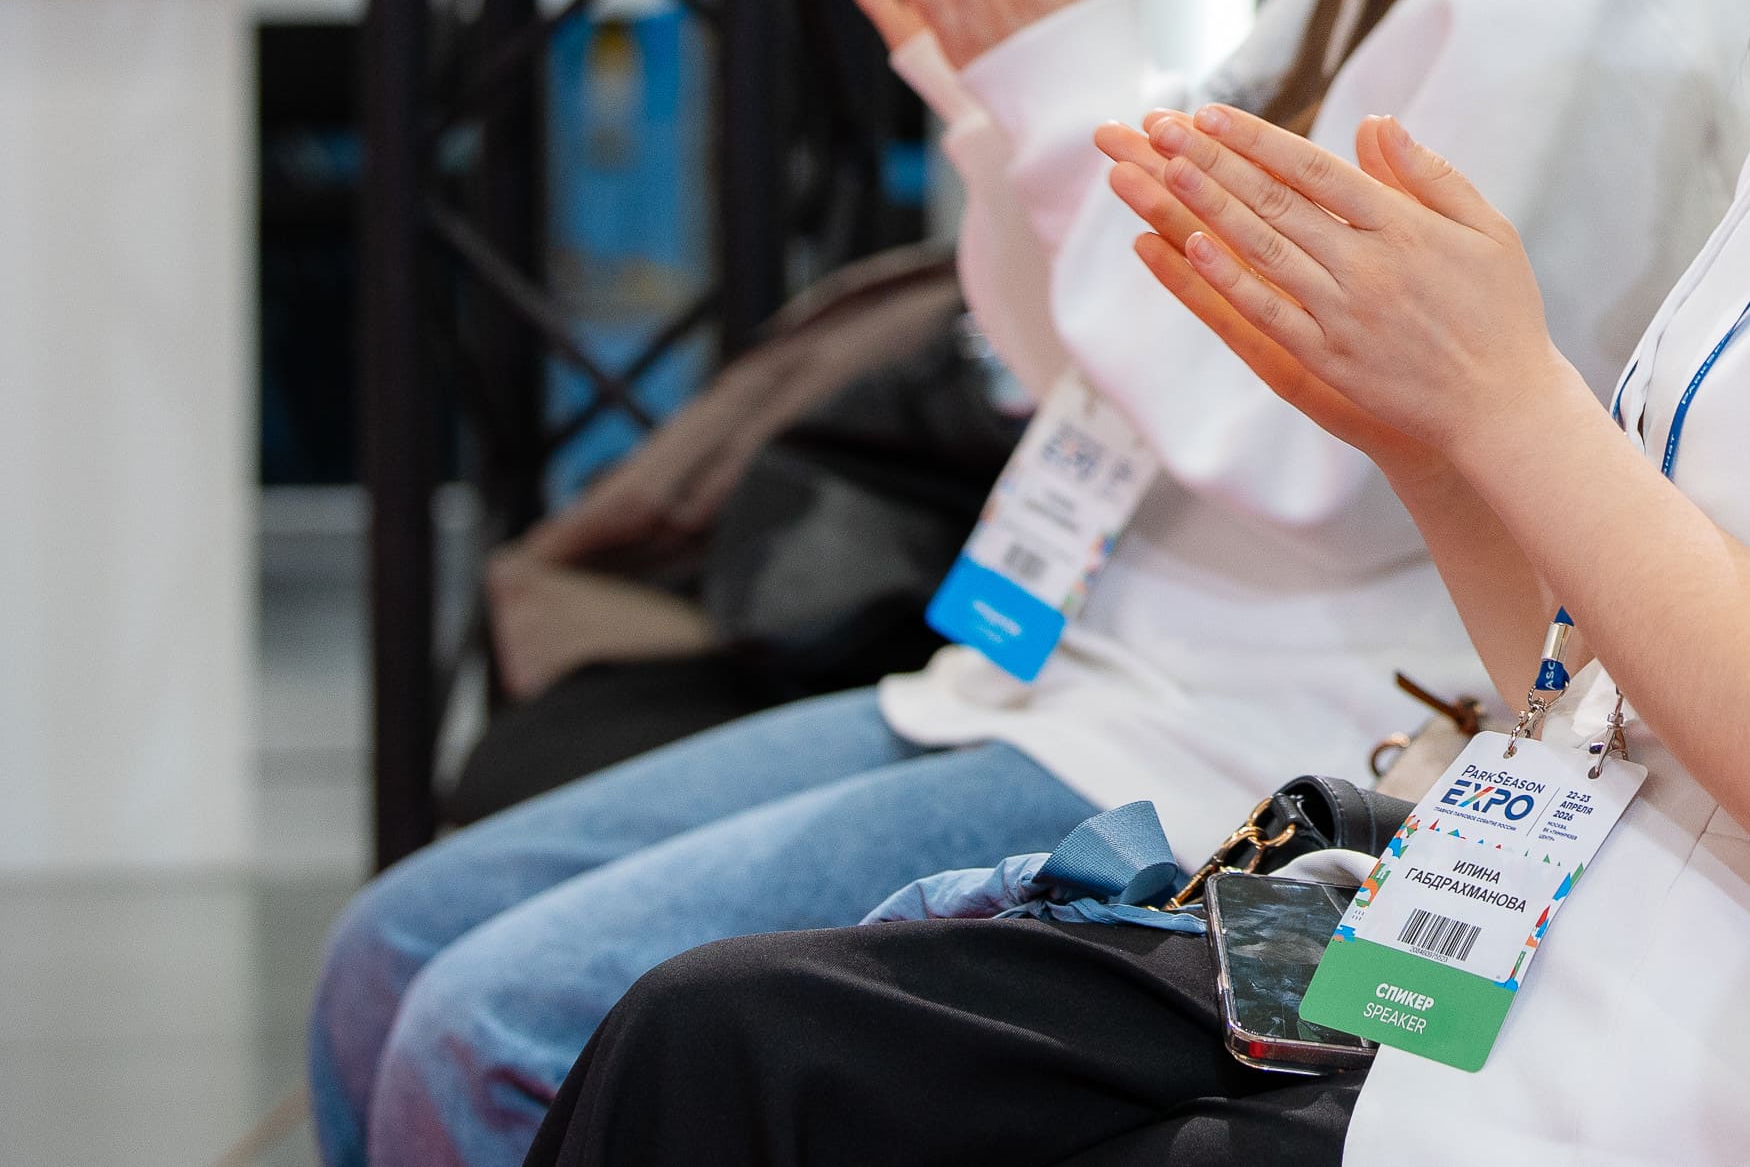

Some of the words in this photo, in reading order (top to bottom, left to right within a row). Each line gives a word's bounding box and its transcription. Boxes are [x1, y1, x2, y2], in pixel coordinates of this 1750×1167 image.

[1461, 764, 1546, 794] PARKSEASON
[1440, 779, 1535, 821] EXPO
[1559, 800, 1594, 816] АПРЕЛЯ
[1566, 790, 1592, 803] 22-23
[1553, 809, 1576, 821] 2026
[1452, 860, 1501, 884] ИЛИНА
[1405, 867, 1527, 913] ГАБДРАХМАНОВА
[1375, 983, 1435, 1011] СПИКЕР
[1363, 1002, 1427, 1035] SPEAKER
